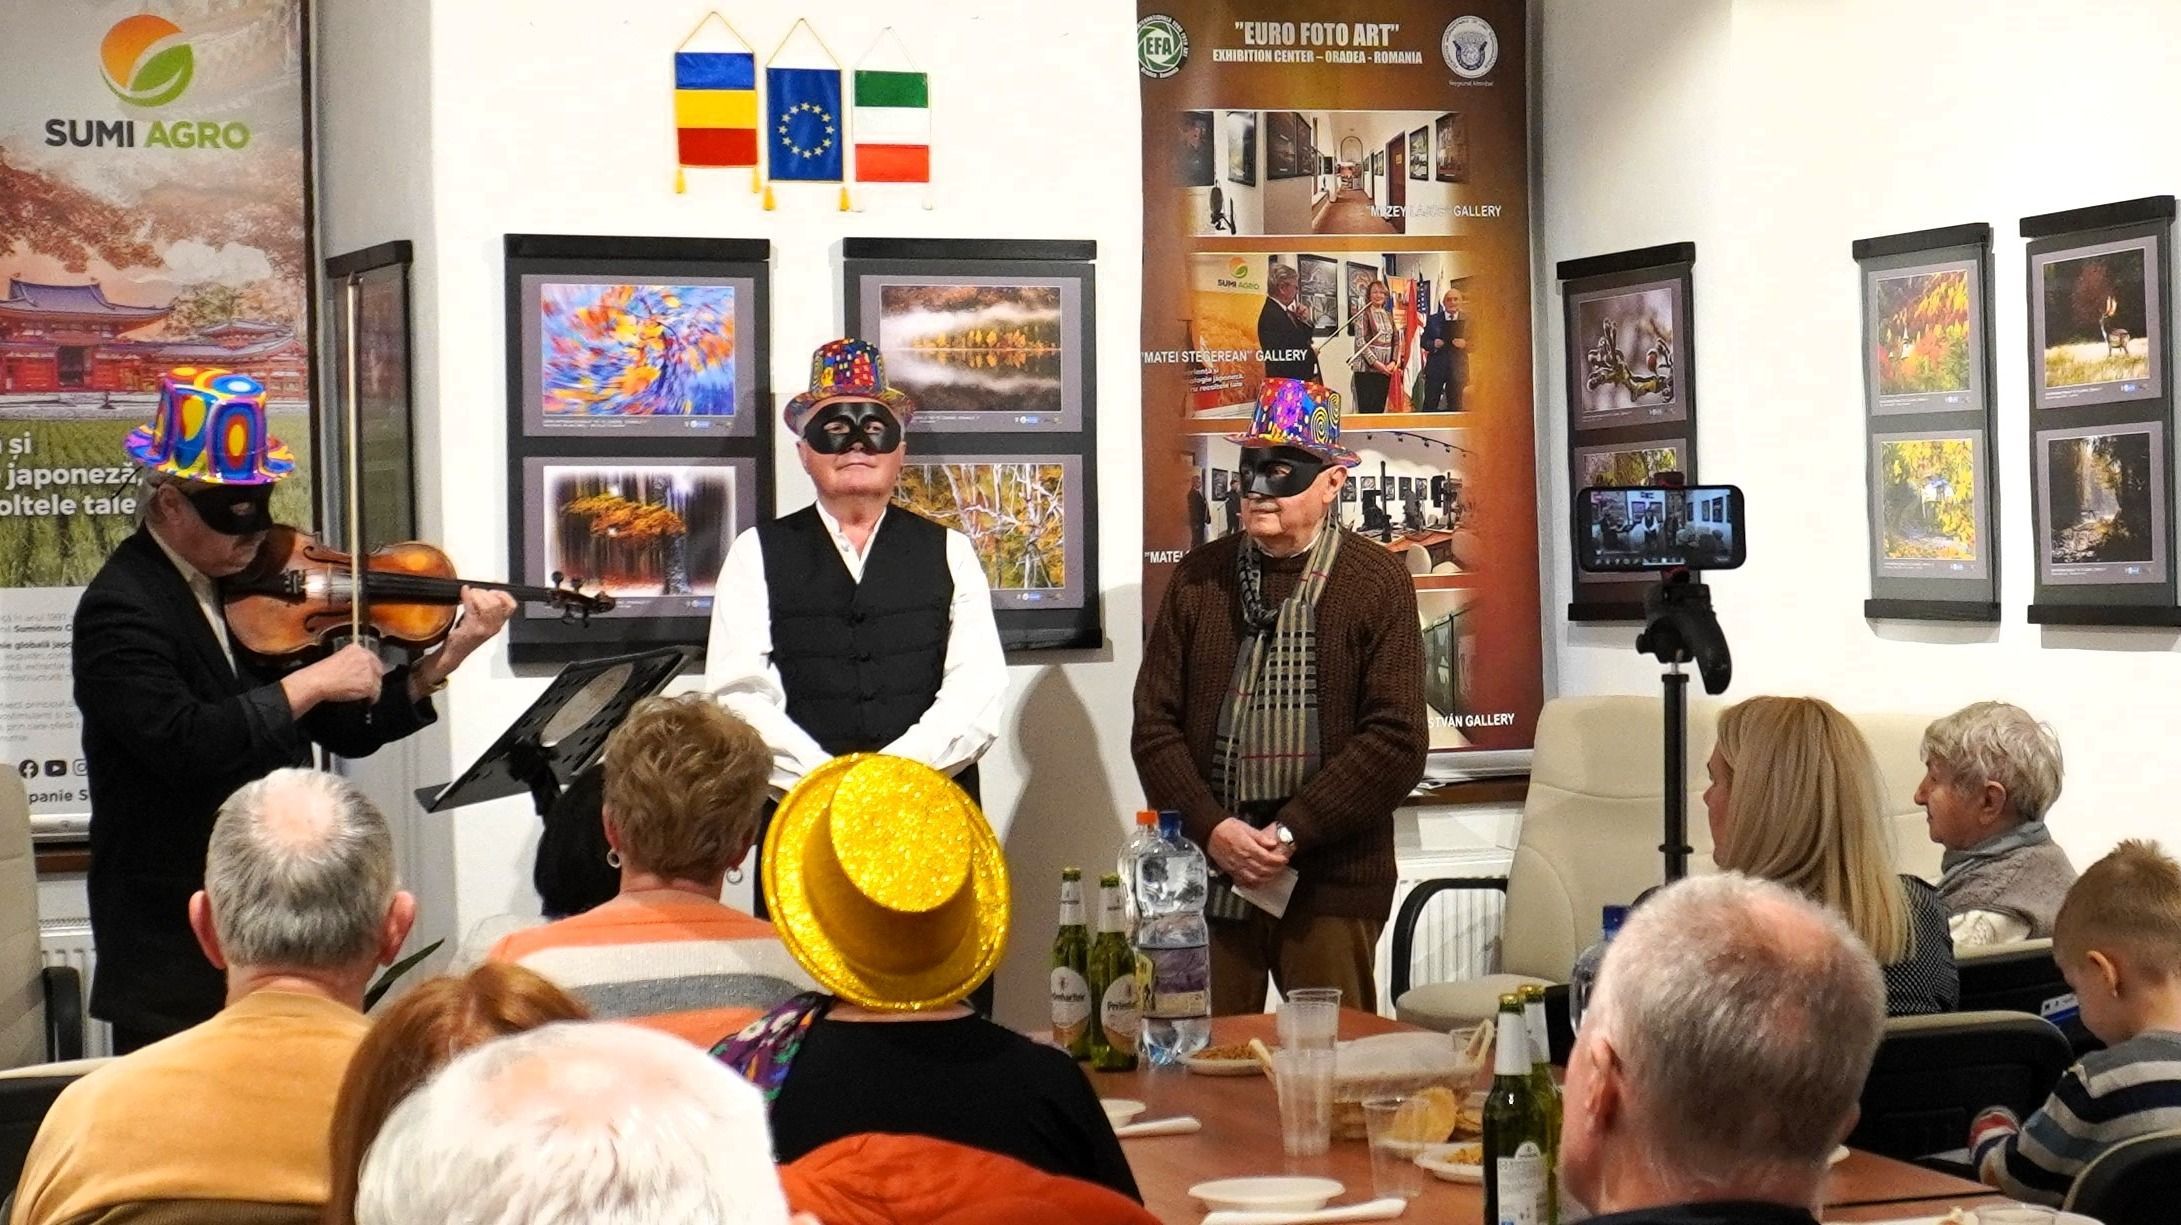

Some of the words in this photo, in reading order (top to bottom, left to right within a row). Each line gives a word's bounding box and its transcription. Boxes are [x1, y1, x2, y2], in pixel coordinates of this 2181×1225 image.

[1234, 22, 1295, 45] "EURO
[1300, 22, 1350, 46] FOTO
[1353, 23, 1400, 47] ART"
[1146, 37, 1172, 55] EFA
[1213, 49, 1273, 63] EXHIBITION
[1274, 50, 1315, 63] CENTER
[1325, 50, 1366, 64] ORADEA
[1374, 50, 1423, 65] ROMANIA
[44, 119, 134, 148] SUMI
[143, 120, 251, 149] AGRO
[1453, 205, 1502, 217] GALLERY
[1255, 349, 1308, 362] GALLERY
[5, 462, 143, 490] japoneză,
[1465, 713, 1515, 727] GALLERY
